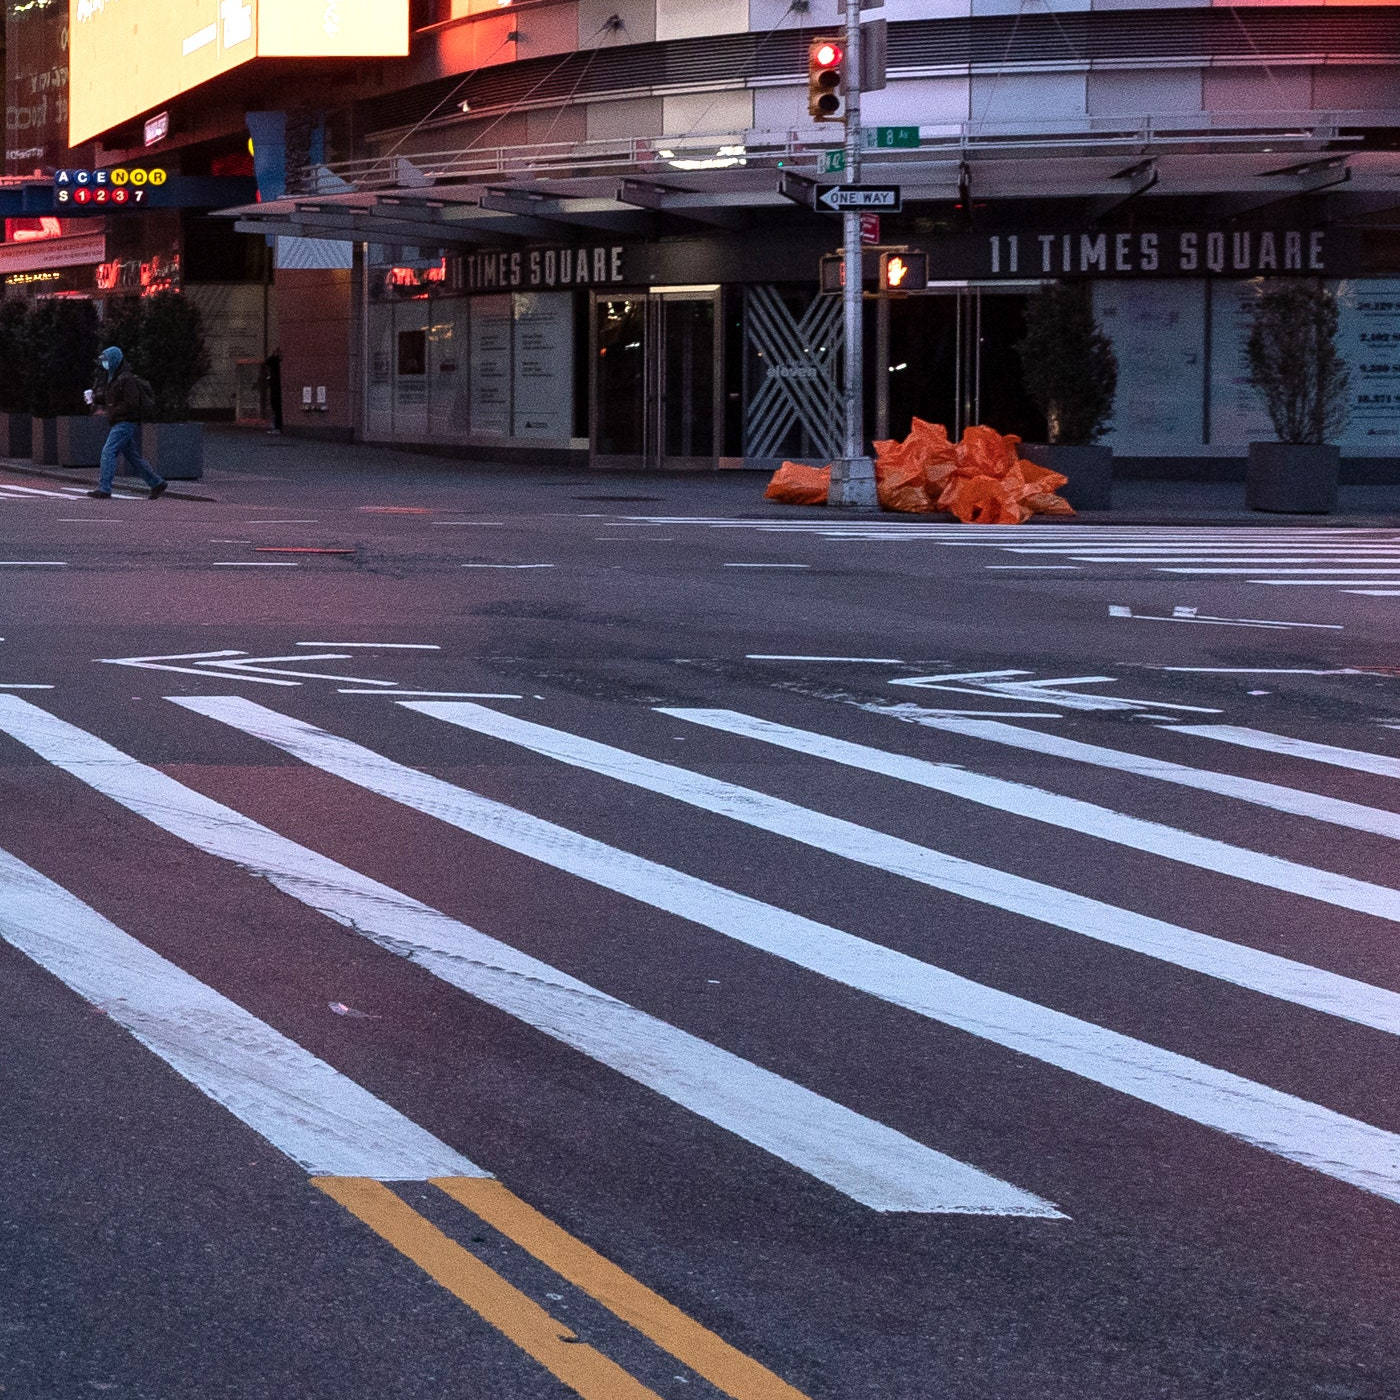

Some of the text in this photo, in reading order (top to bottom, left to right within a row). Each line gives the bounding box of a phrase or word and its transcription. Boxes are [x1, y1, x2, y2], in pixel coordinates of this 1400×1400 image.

[886, 129, 894, 145] 8
[830, 192, 890, 204] ONE WAY
[990, 230, 1325, 273] 11 TIMES SQUARE
[467, 251, 521, 288] TIMES
[530, 246, 624, 286] SQUARE
